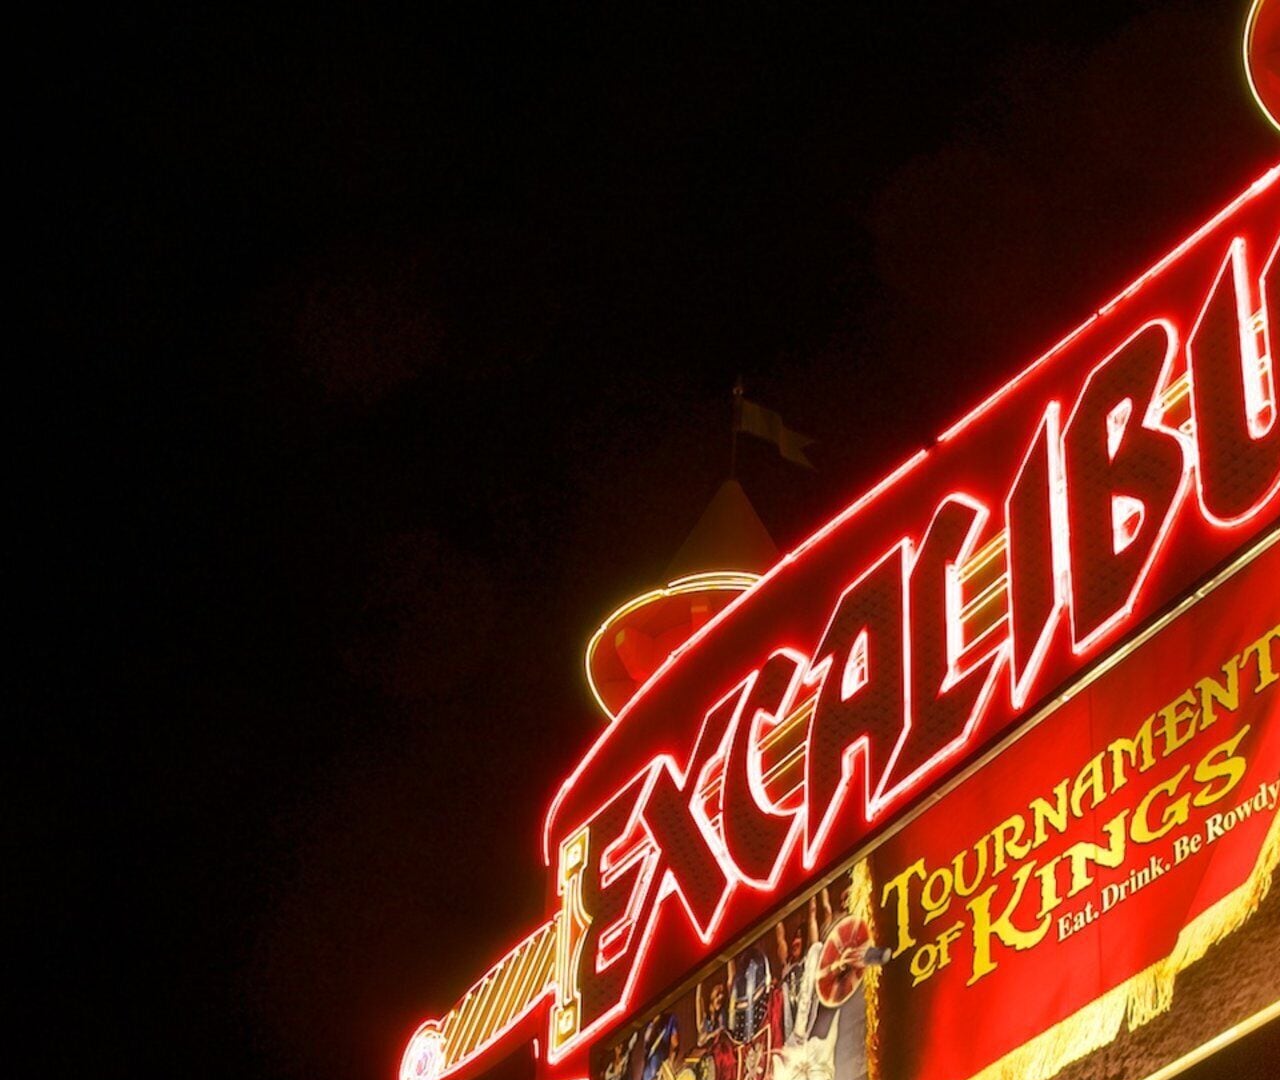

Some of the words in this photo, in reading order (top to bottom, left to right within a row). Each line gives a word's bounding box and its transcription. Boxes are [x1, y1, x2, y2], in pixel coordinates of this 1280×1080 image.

[966, 724, 1251, 987] KINGS
[1057, 908, 1099, 942] Eat.
[1101, 860, 1171, 914] Drink.
[1173, 833, 1202, 867] Be
